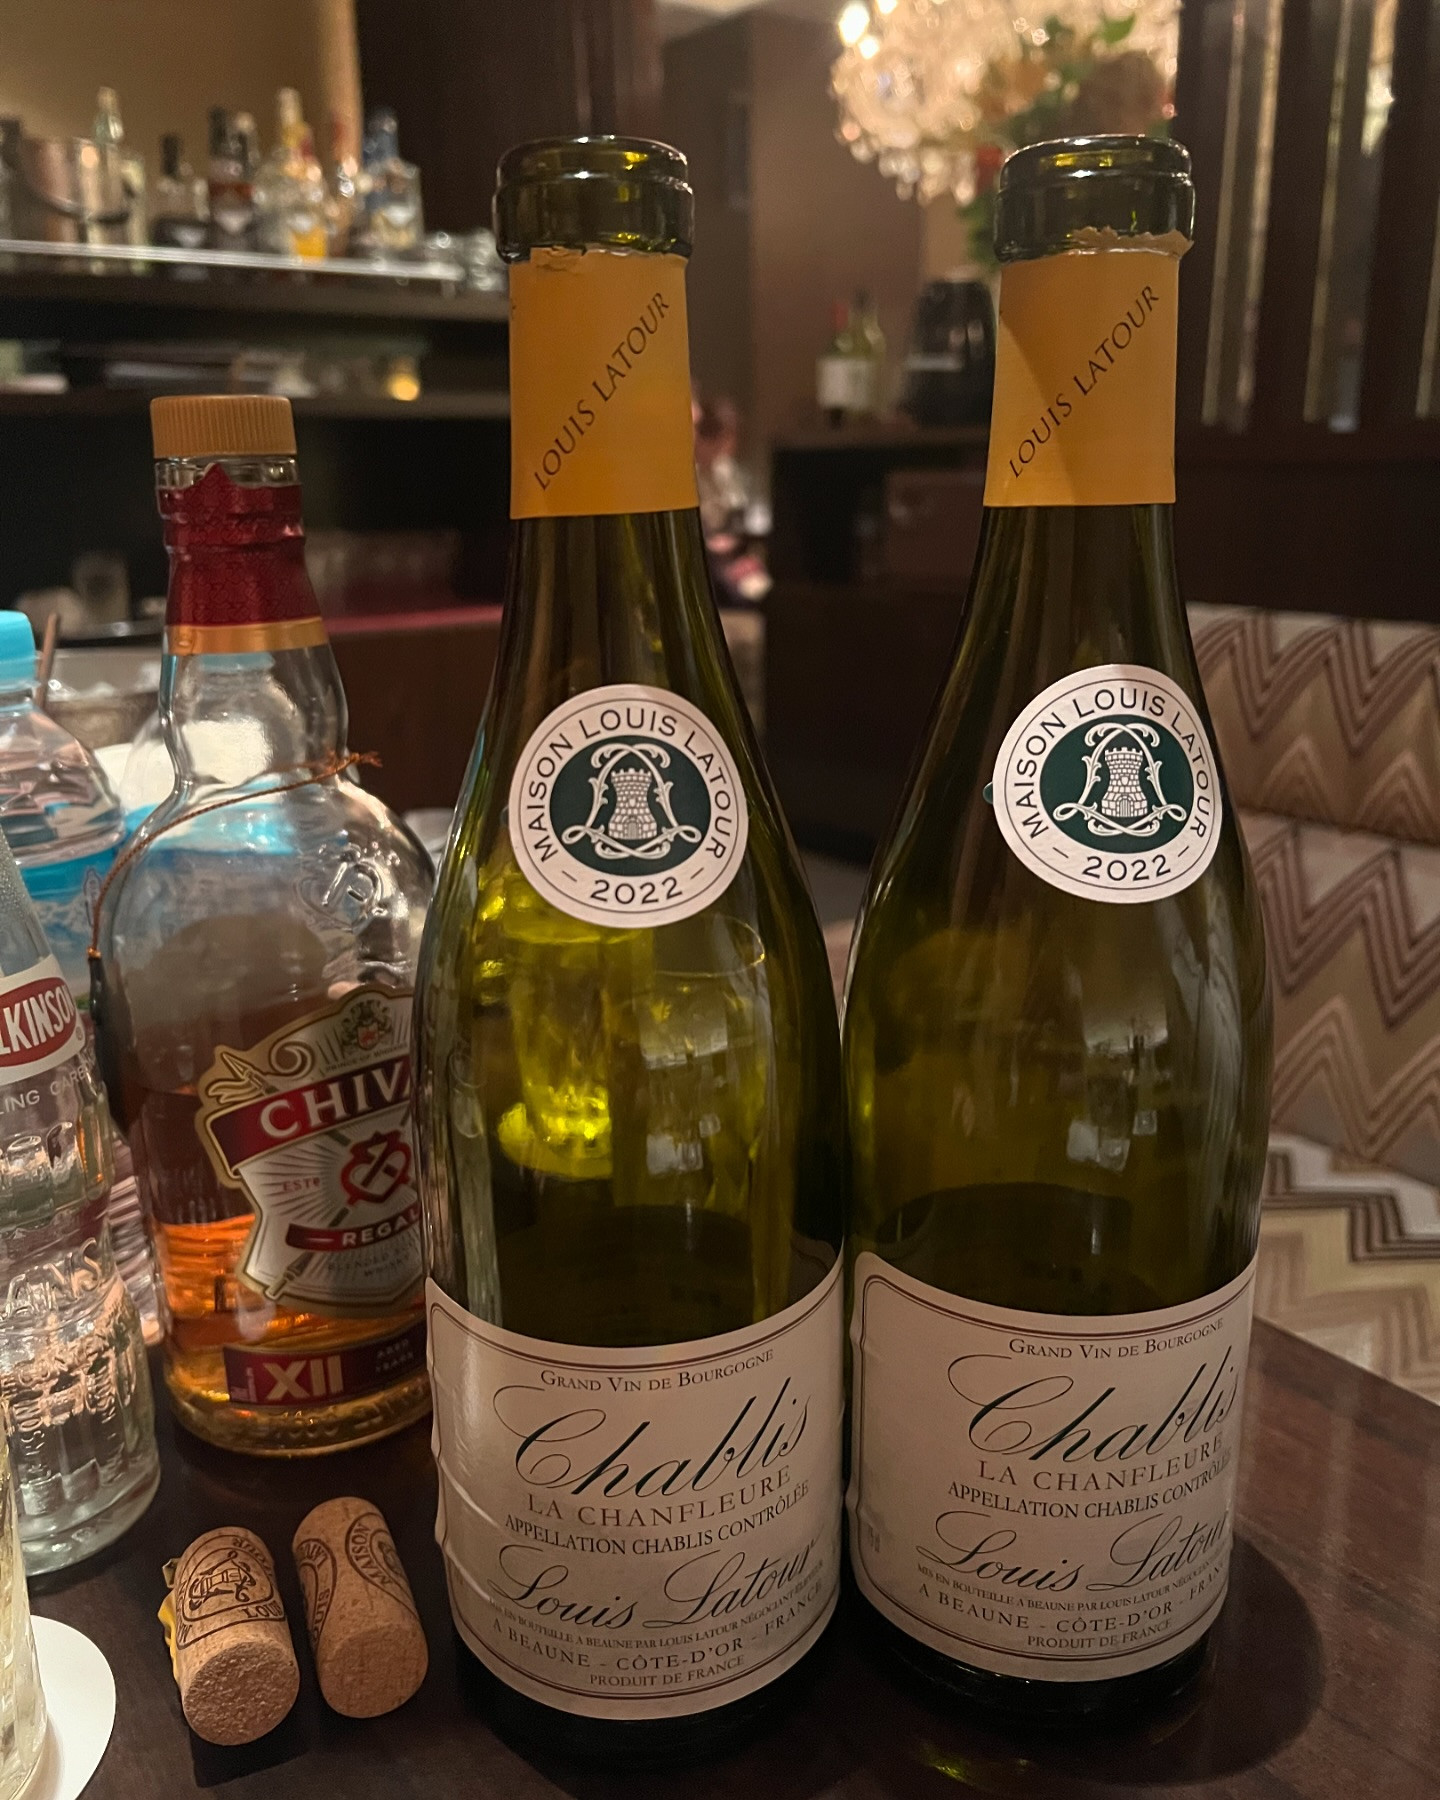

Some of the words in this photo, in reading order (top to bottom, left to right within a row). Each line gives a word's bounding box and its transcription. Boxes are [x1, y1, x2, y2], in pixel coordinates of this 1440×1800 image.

[534, 399, 595, 491] LOUIS
[591, 292, 670, 402] LATOUR
[1009, 393, 1072, 478] LOUIS
[1073, 285, 1159, 396] LATOUR
[527, 733, 574, 862] MAISON
[578, 707, 678, 739] LOUIS
[683, 731, 732, 859] LATOUR
[1014, 712, 1067, 838] MAISON
[1072, 688, 1166, 718] LOUIS
[1171, 711, 1211, 838] LATOUR
[590, 876, 683, 905] 2022
[1082, 854, 1171, 882] 2022
[342, 1208, 420, 1246] REGAL
[1009, 1338, 1072, 1359] GRAND
[1079, 1344, 1111, 1359] VIN
[1118, 1345, 1139, 1357] DE
[1144, 1317, 1224, 1354] BOURGOGNE
[263, 1355, 344, 1400] XII
[540, 1369, 601, 1391] GRAND
[608, 1376, 641, 1392] VIN
[649, 1378, 672, 1391] DE
[678, 1349, 774, 1388] BOURGOGNE
[947, 1345, 1240, 1462] Chablis
[493, 1376, 812, 1498] Chablis
[979, 1460, 1017, 1486] LA
[1033, 1431, 1223, 1491] CHANFLEURE
[505, 1513, 626, 1555] APPELLATION
[632, 1530, 713, 1555] CHABLIS
[718, 1479, 809, 1541] CONTRÔLÉE
[528, 1492, 564, 1520] LA
[578, 1464, 791, 1527] CHANFLEURE
[948, 1481, 1079, 1518] APPELLATION
[1084, 1493, 1159, 1518] CHABLIS
[487, 1544, 638, 1630] Louis
[642, 1521, 826, 1629] Latour
[915, 1510, 1085, 1592] Louis
[938, 1591, 1029, 1629] BEAUNE
[1056, 1601, 1172, 1633] CÔTE-D'OR
[1028, 1599, 1075, 1611] BEAUNE
[1077, 1602, 1097, 1611] PAR
[1100, 1597, 1132, 1610] LOUIS
[1134, 1586, 1170, 1603] LATOUR
[508, 1627, 590, 1667] BEAUNE
[616, 1637, 743, 1670] CÔTE-D'OR
[765, 1580, 823, 1636] FRANCE
[586, 1637, 634, 1648] BEAUNE
[636, 1639, 656, 1649] PAR
[659, 1633, 693, 1648] LOUIS
[695, 1621, 738, 1641] LATOUR
[1027, 1635, 1095, 1648] PRODUIT
[1100, 1636, 1117, 1647] DE
[1122, 1618, 1172, 1643] FRANCE
[590, 1675, 657, 1687] PRODUIT
[662, 1673, 683, 1685] DE
[687, 1655, 745, 1681] FRANCE
